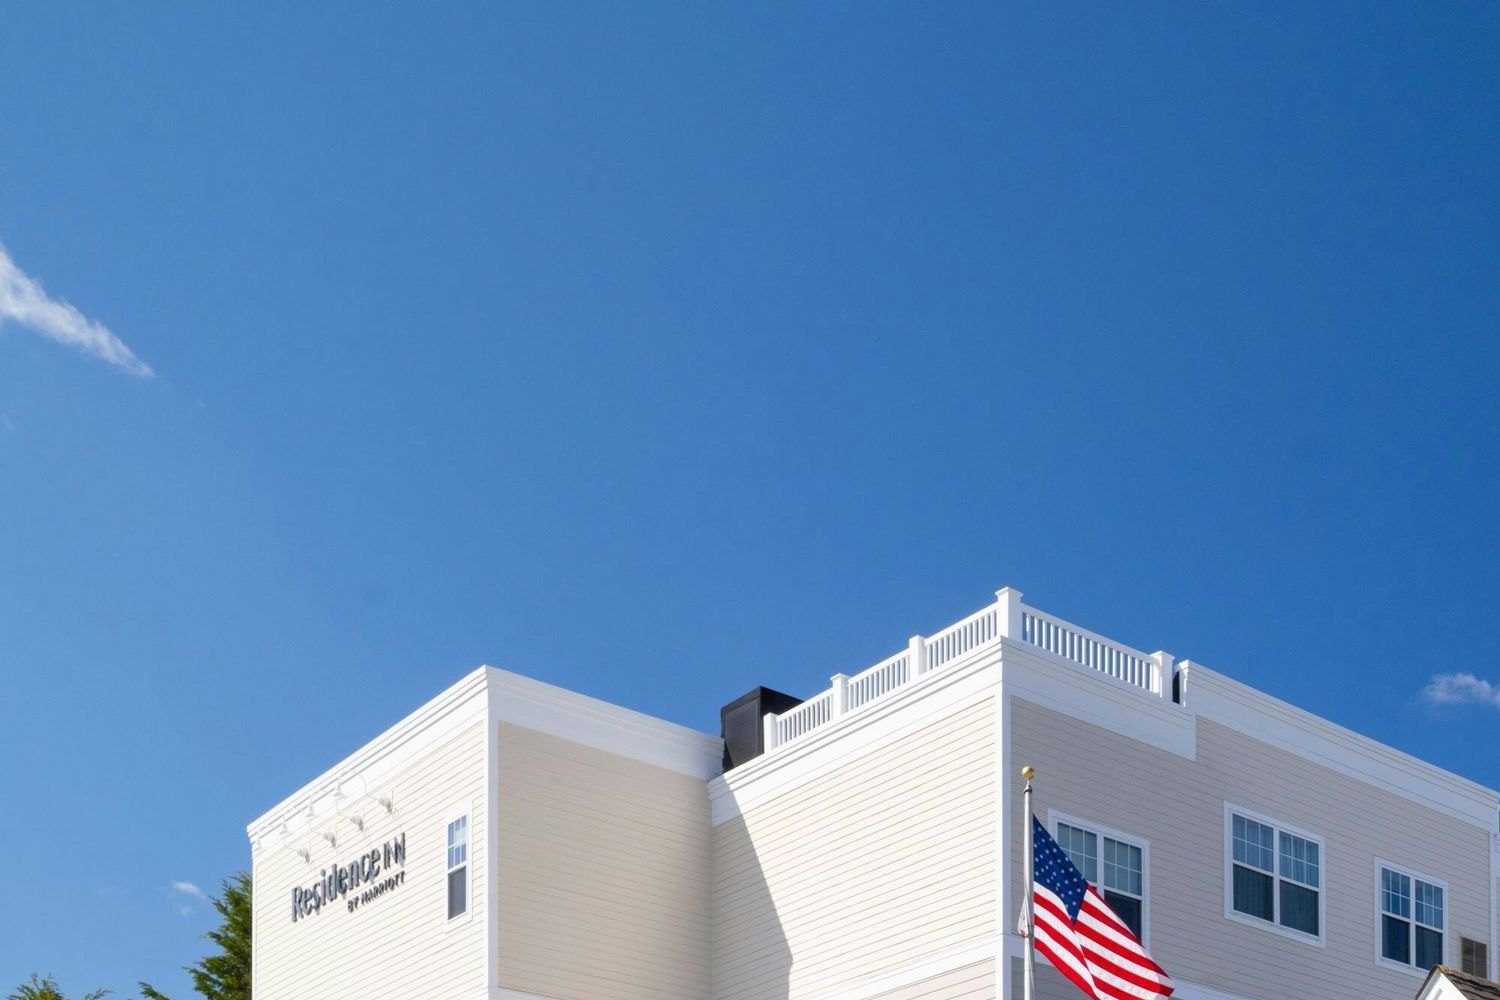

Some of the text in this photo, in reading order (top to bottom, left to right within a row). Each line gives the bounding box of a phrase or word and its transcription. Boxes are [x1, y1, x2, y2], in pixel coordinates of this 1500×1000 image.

[291, 848, 381, 923] Residence
[347, 869, 406, 913] BY MARRIOTT
